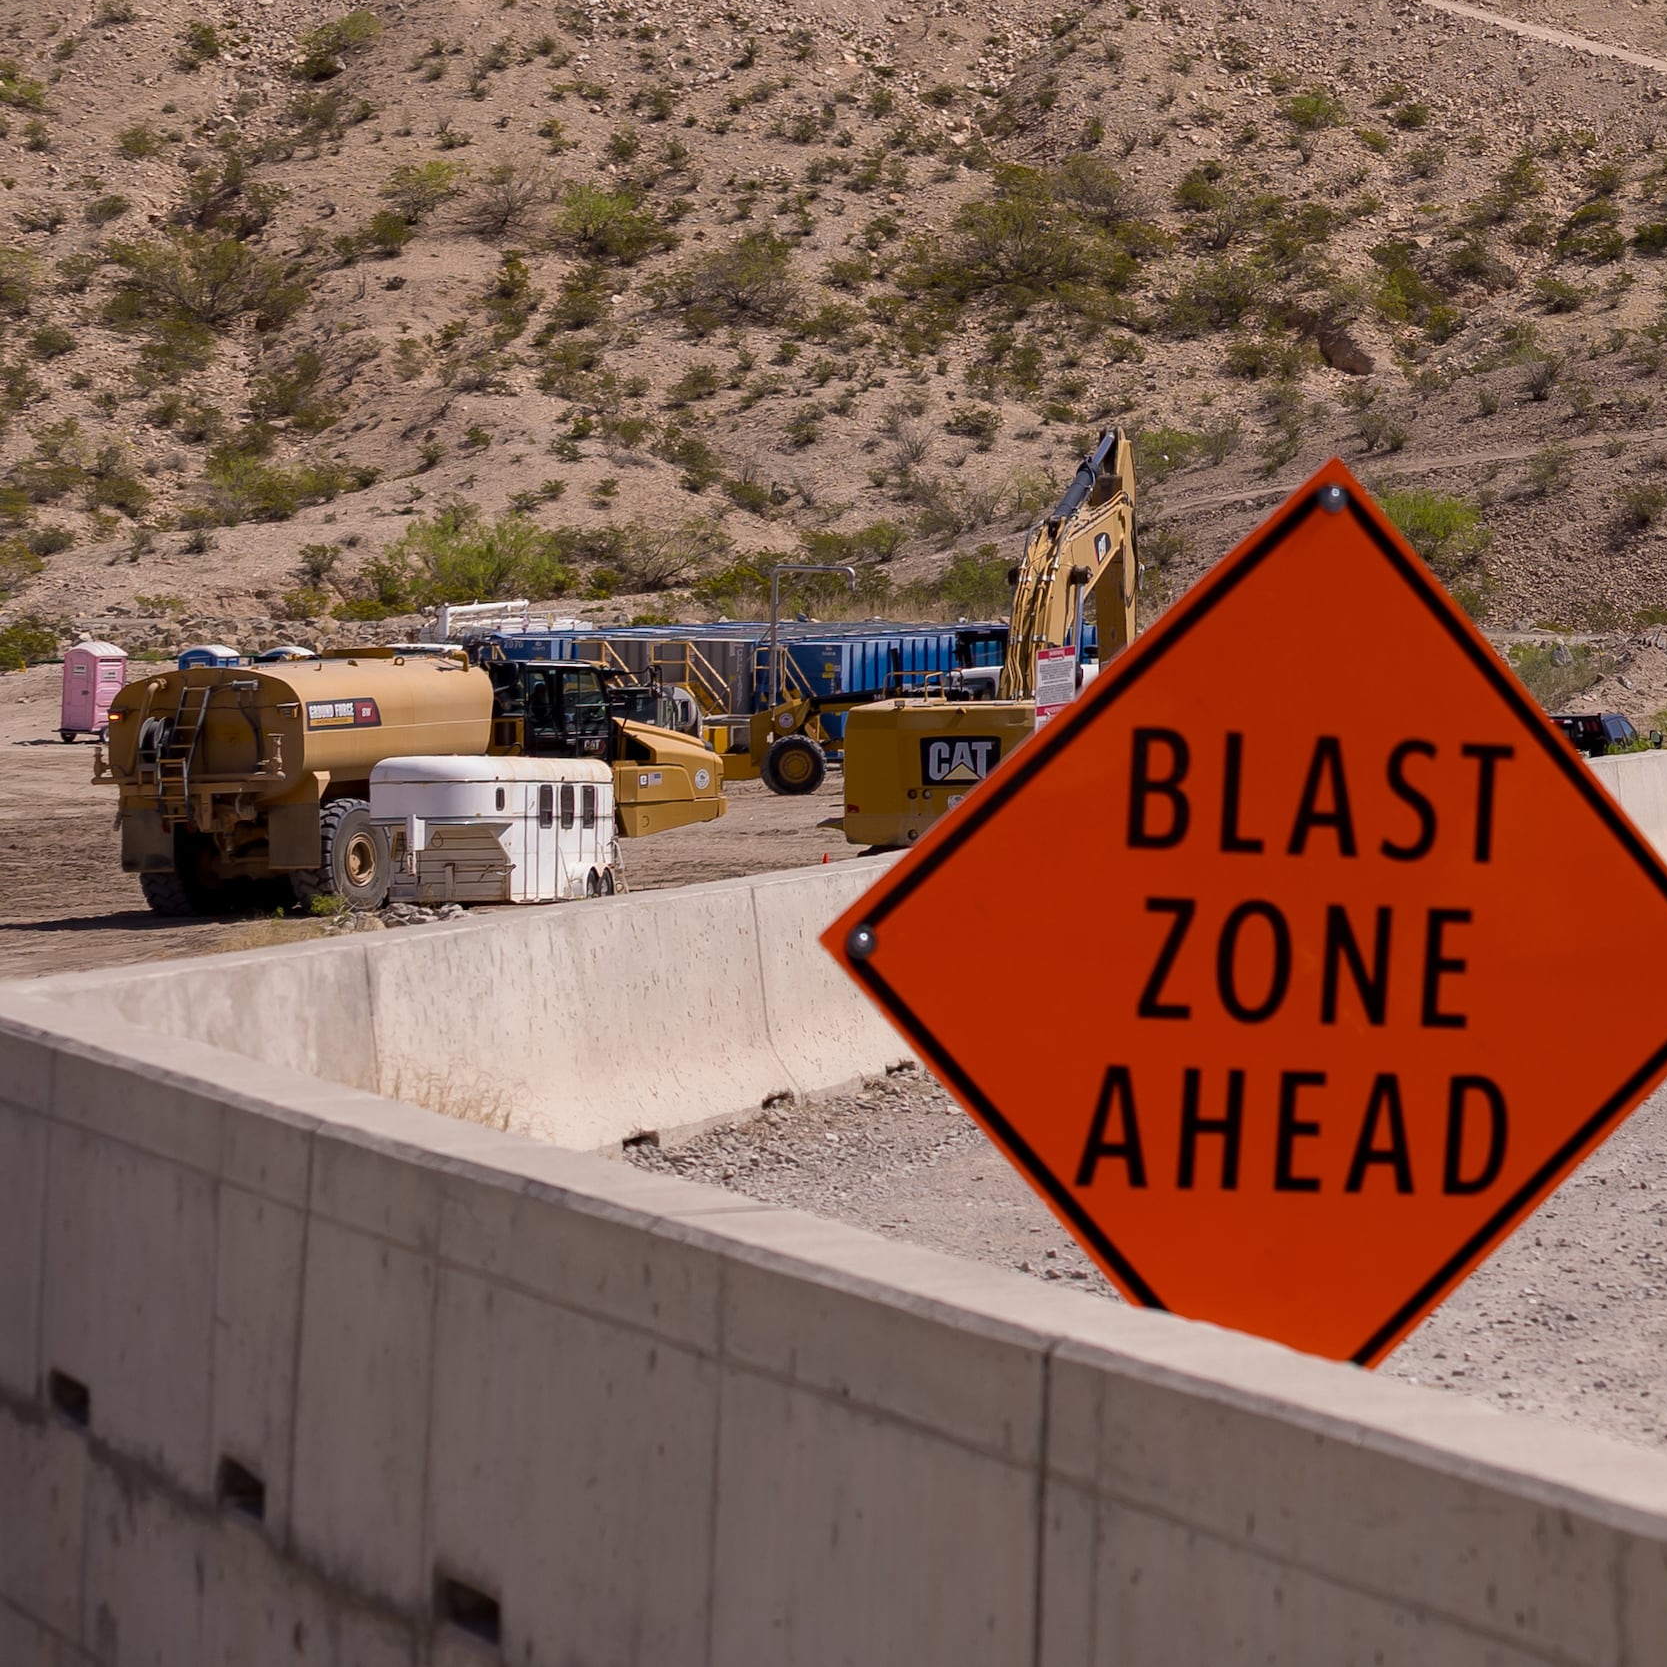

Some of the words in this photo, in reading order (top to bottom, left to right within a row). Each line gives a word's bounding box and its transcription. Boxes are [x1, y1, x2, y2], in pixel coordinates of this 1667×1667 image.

[583, 739, 601, 751] CAT
[928, 741, 993, 781] CAT
[1126, 726, 1515, 865] BLAST
[1136, 897, 1474, 1031] ZONE
[1074, 1064, 1510, 1197] AHEAD
